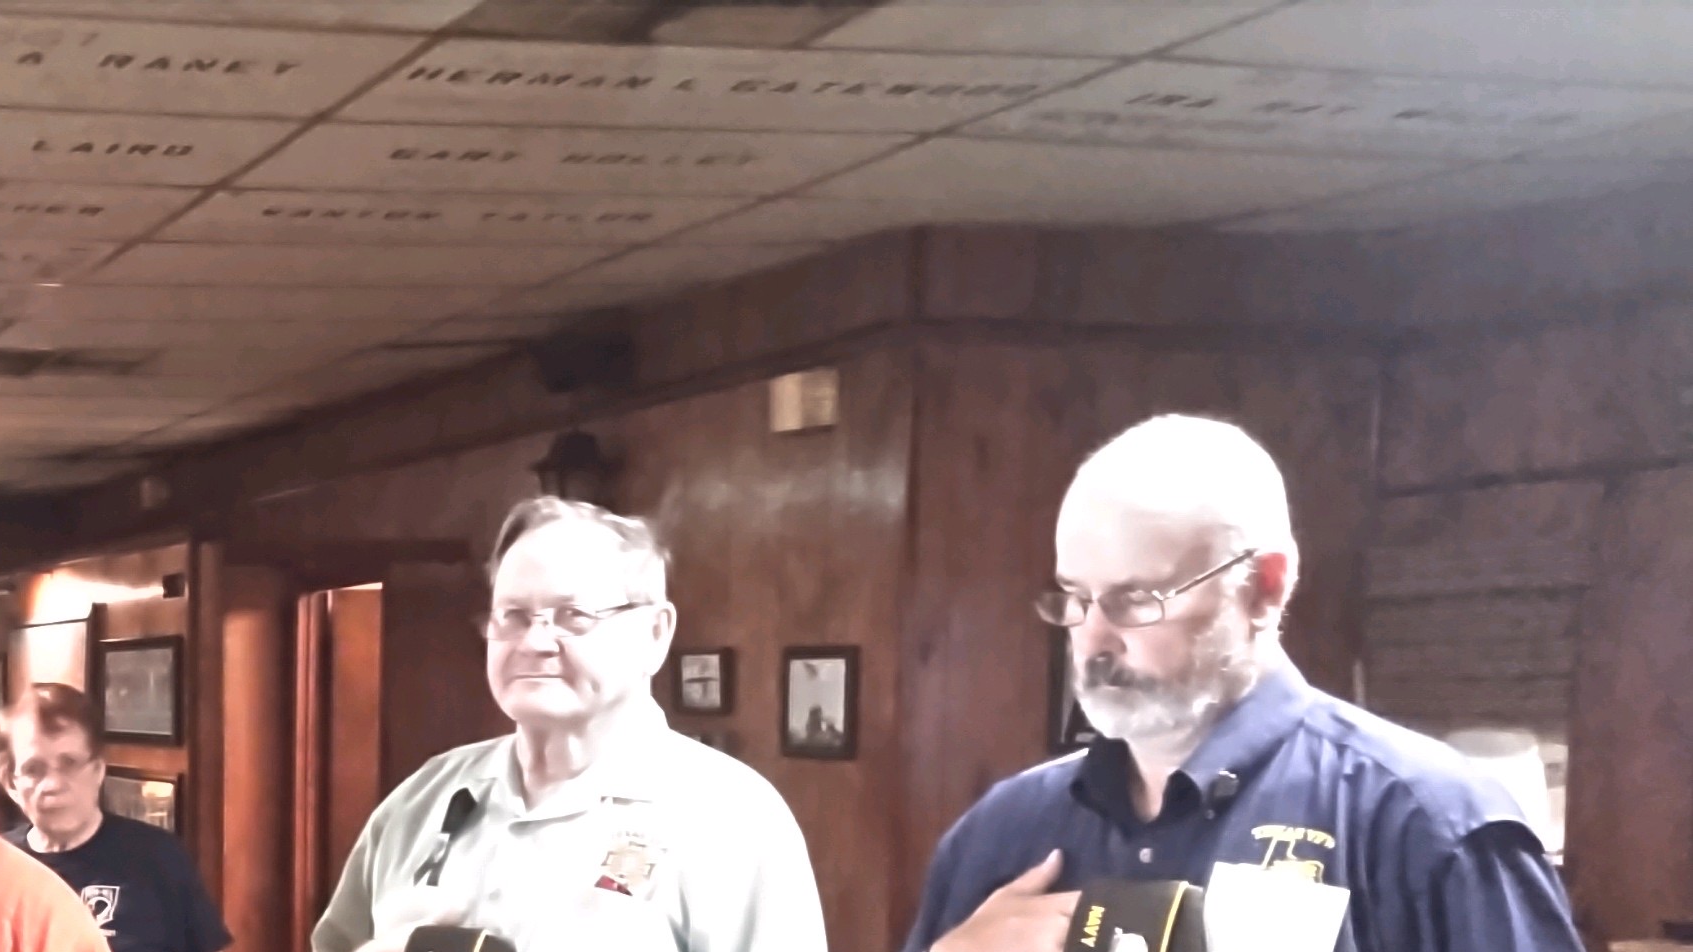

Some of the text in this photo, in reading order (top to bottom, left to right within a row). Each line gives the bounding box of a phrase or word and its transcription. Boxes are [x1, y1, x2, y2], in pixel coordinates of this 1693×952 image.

[16, 51, 45, 66] A
[408, 66, 653, 90] HERMAN
[31, 139, 195, 157] LAIRD
[1080, 905, 1106, 948] NAVY
